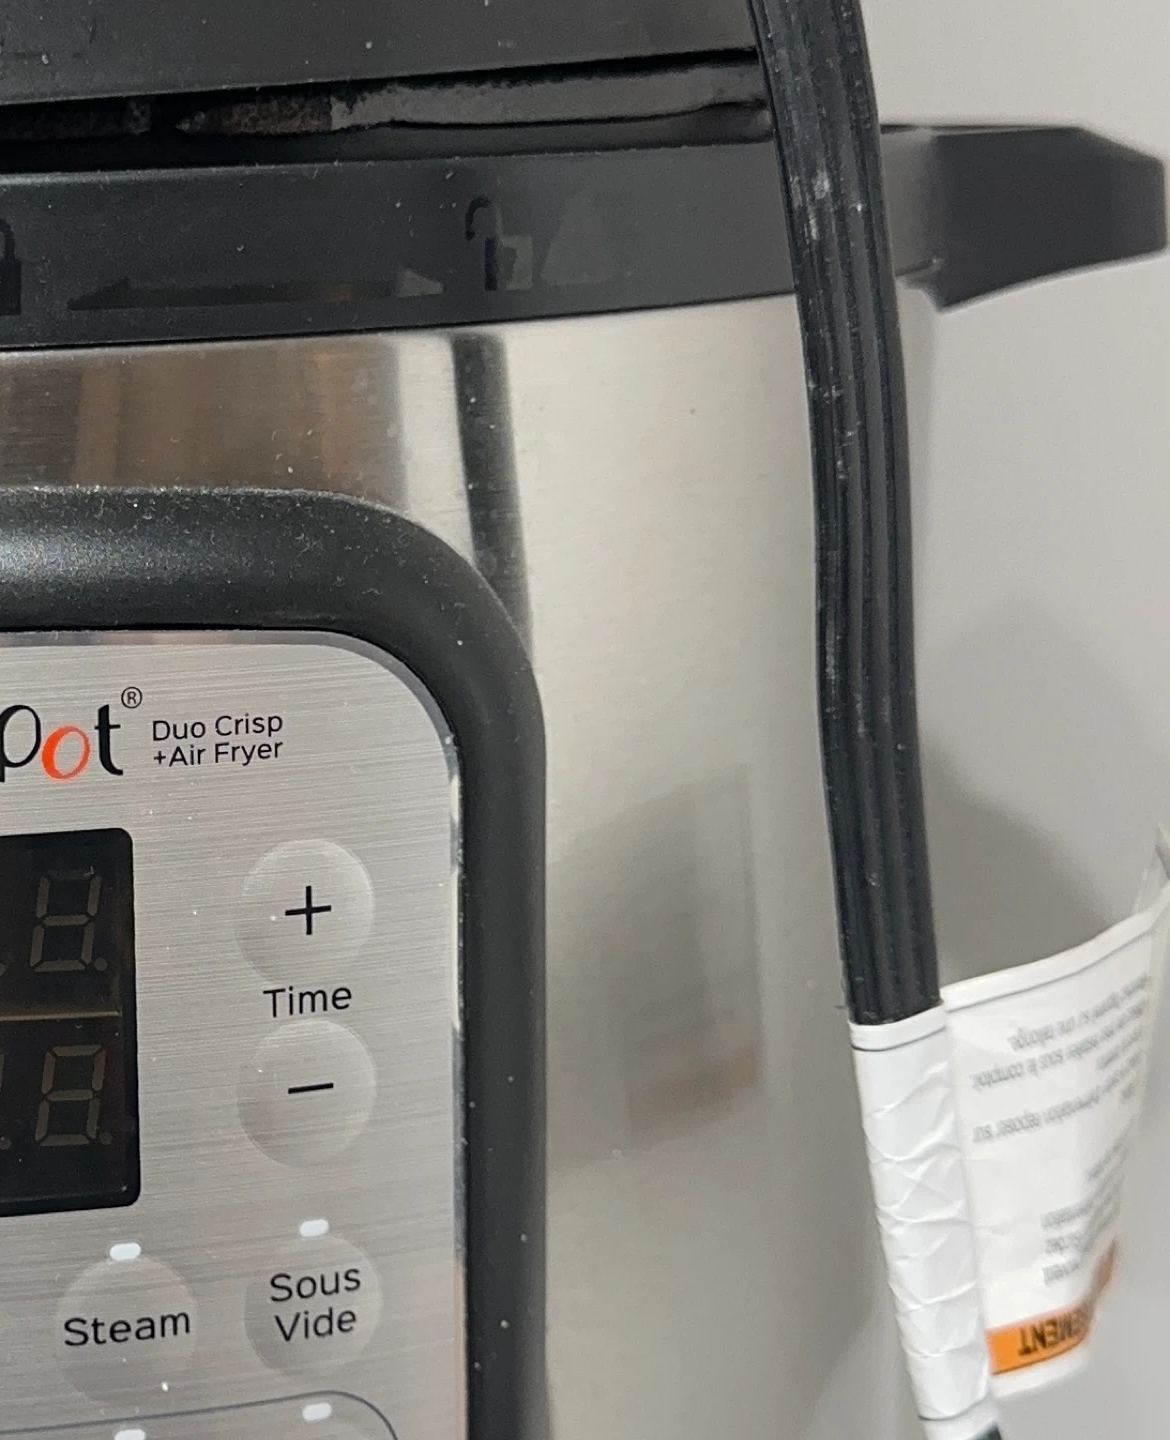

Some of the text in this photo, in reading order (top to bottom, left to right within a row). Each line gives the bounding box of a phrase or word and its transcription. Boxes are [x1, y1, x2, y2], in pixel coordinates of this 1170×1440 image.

[153, 716, 282, 741] Duo Crisp
[154, 742, 283, 767] +Air Fryer
[263, 986, 352, 1018] Time
[270, 1269, 360, 1302] Sous
[64, 1313, 190, 1346] Steam
[275, 1307, 356, 1341] Vide
